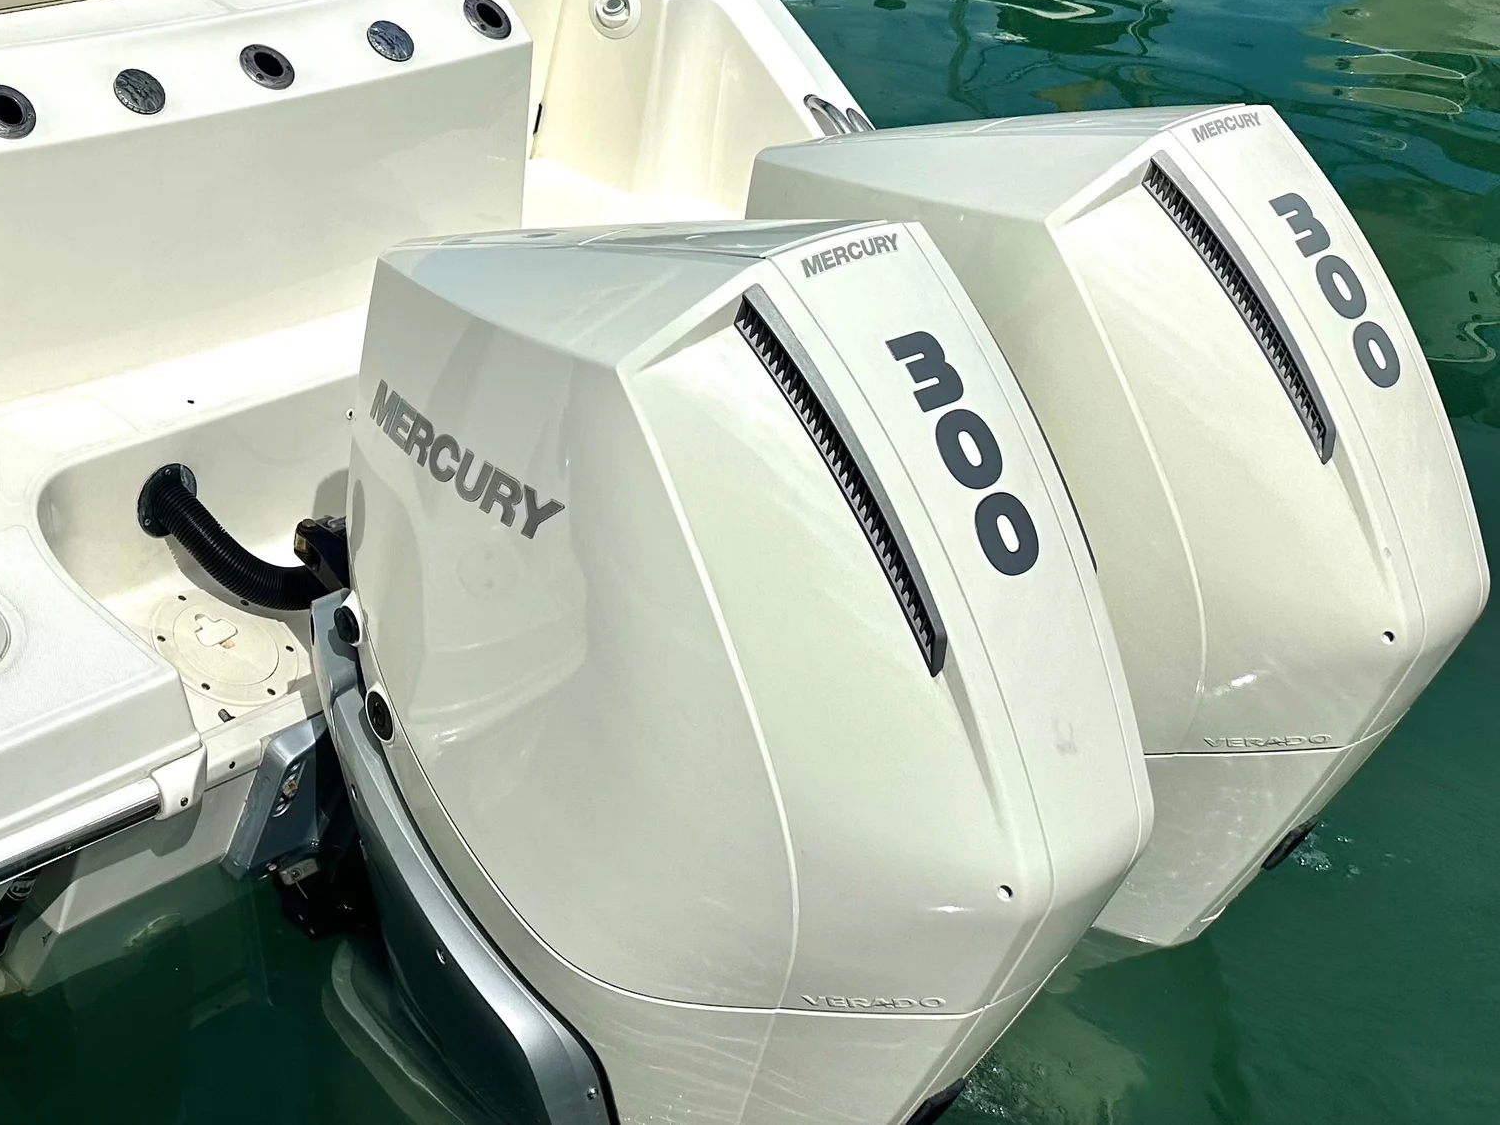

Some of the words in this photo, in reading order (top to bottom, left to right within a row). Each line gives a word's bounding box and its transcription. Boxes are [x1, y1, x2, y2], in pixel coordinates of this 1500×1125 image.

[1191, 111, 1261, 144] MERCURY
[800, 233, 899, 278] MERCURY
[1268, 192, 1401, 389] 300
[369, 378, 566, 540] MERCURY
[885, 330, 1040, 577] 300
[1203, 733, 1333, 748] VERADO
[800, 994, 948, 1009] VERADO
